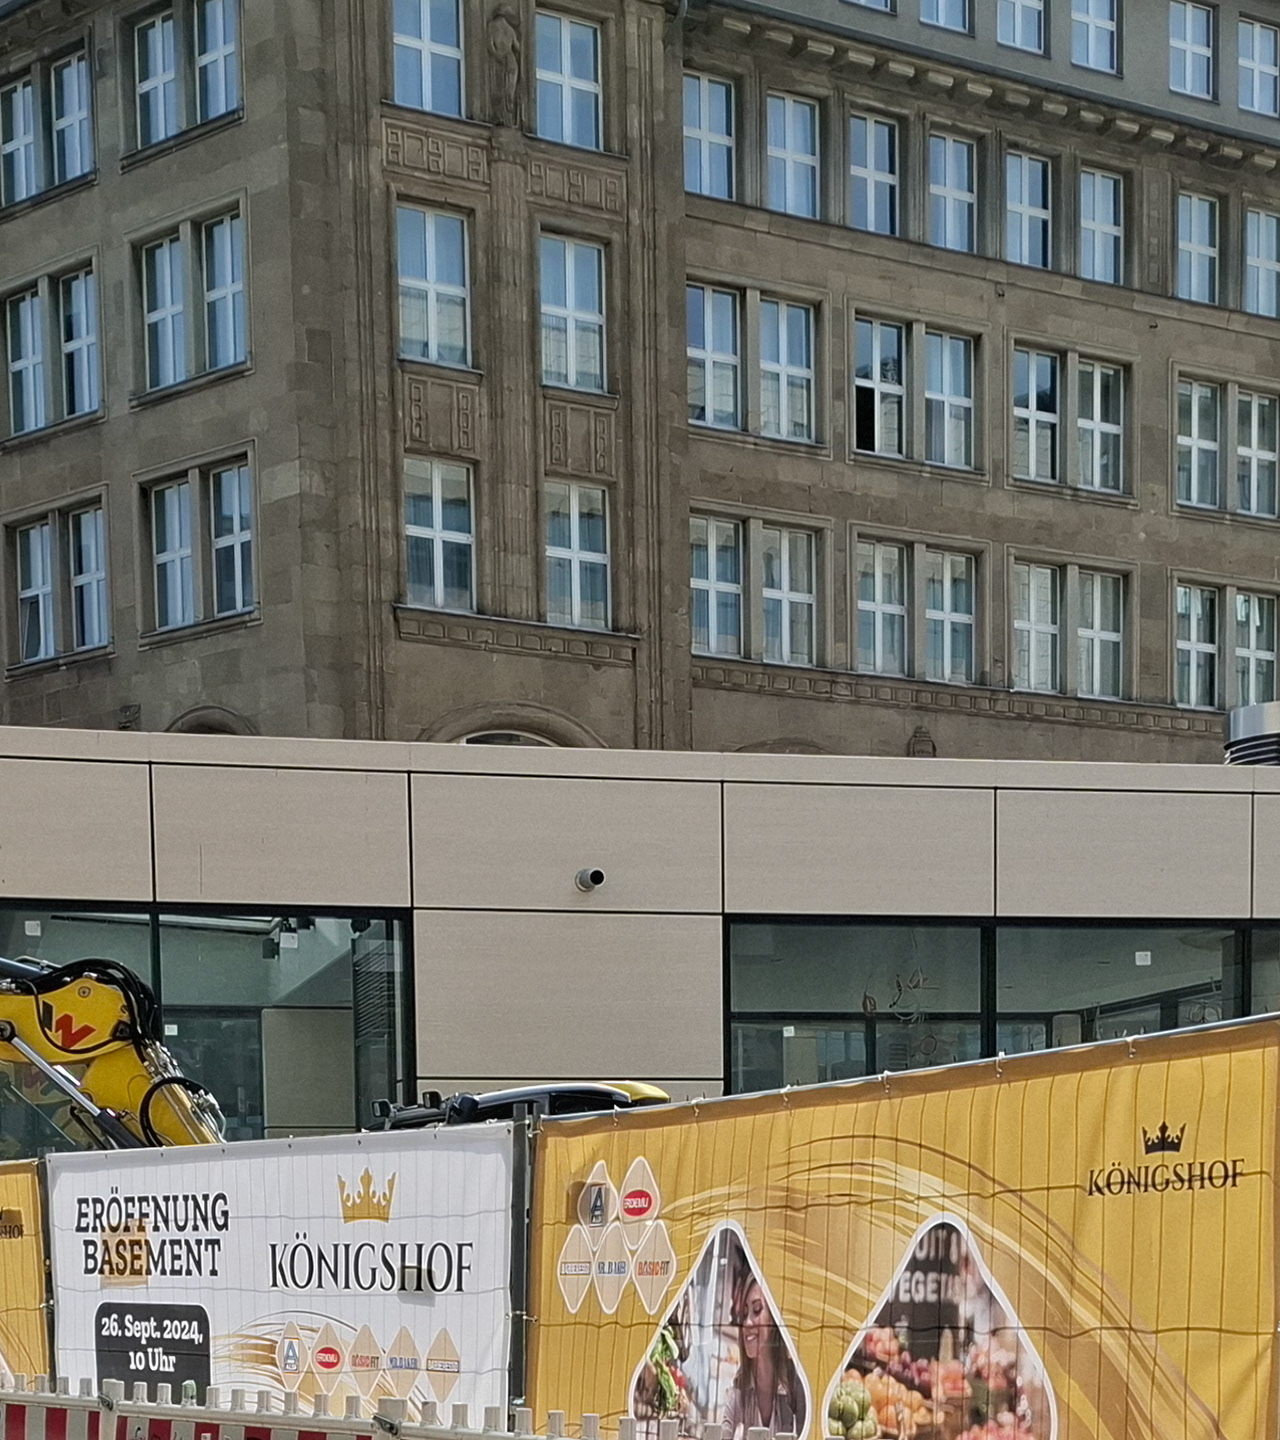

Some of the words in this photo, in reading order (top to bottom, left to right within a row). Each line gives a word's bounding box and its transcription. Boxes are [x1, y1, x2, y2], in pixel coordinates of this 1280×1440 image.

[1088, 1159, 1245, 1197] KÖNIGSHOF
[75, 1186, 230, 1233] ERÖFFNUNG
[83, 1238, 222, 1277] BASEMENT
[269, 1231, 473, 1293] KÖNIGSHOF
[101, 1313, 122, 1337] 26.
[124, 1314, 160, 1345] Sept.
[163, 1319, 203, 1345] 2024,
[129, 1350, 146, 1370] 10
[147, 1347, 176, 1372] Uhr
